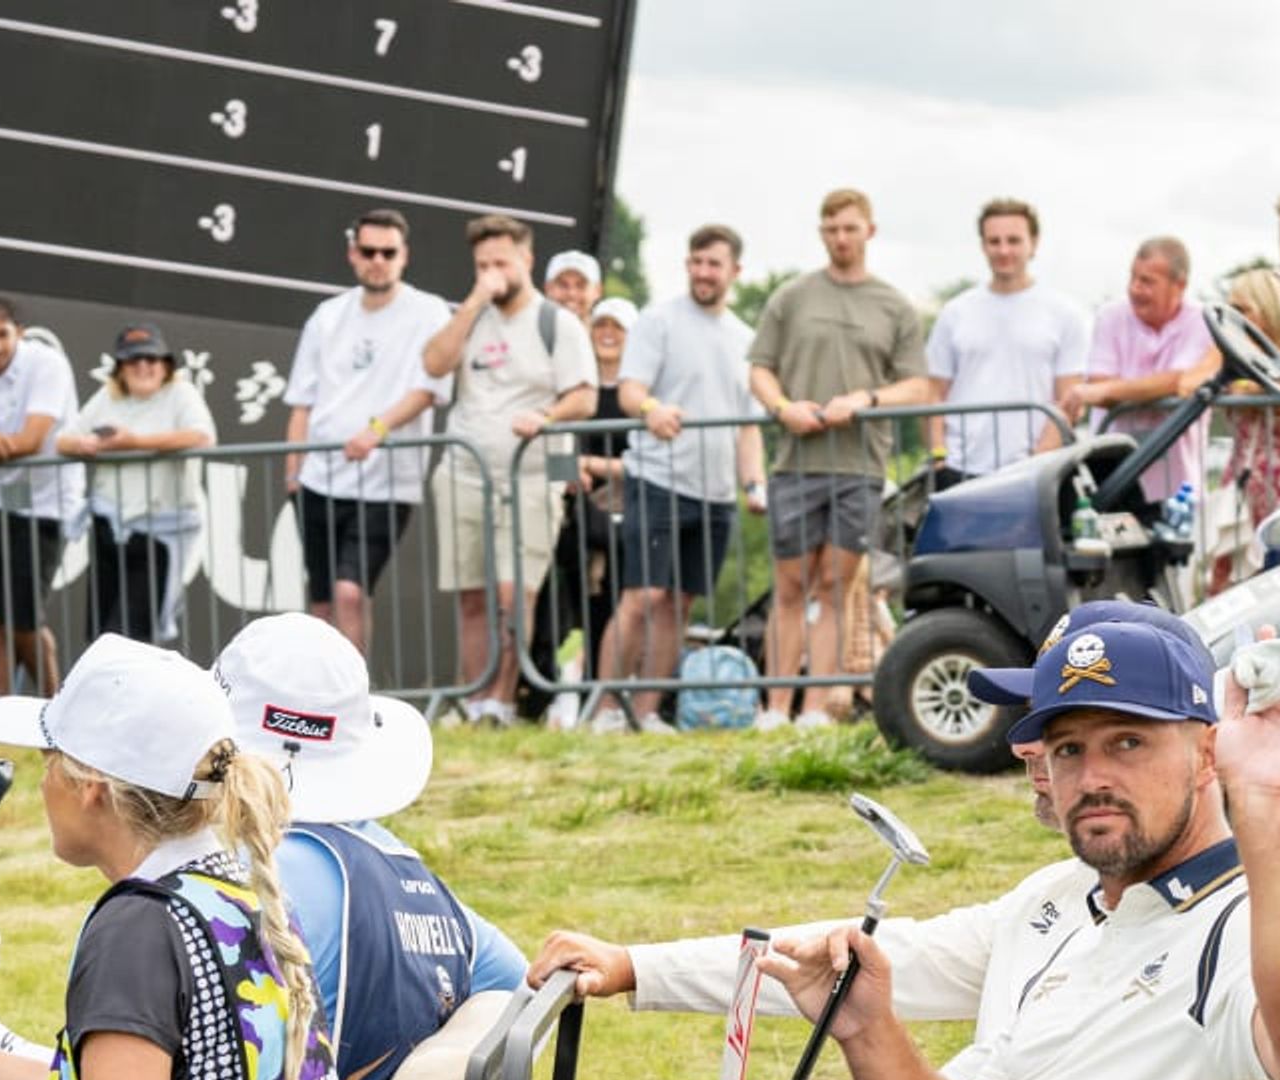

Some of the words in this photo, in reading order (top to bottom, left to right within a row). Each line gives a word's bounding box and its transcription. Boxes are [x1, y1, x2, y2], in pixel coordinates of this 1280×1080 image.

[374, 19, 397, 55] 7
[507, 45, 543, 82] -3
[210, 100, 247, 138] -3
[366, 123, 382, 159] 1
[498, 147, 527, 182] -1
[198, 203, 236, 242] -3
[266, 711, 330, 737] Titleist
[393, 911, 457, 956] HOWELL
